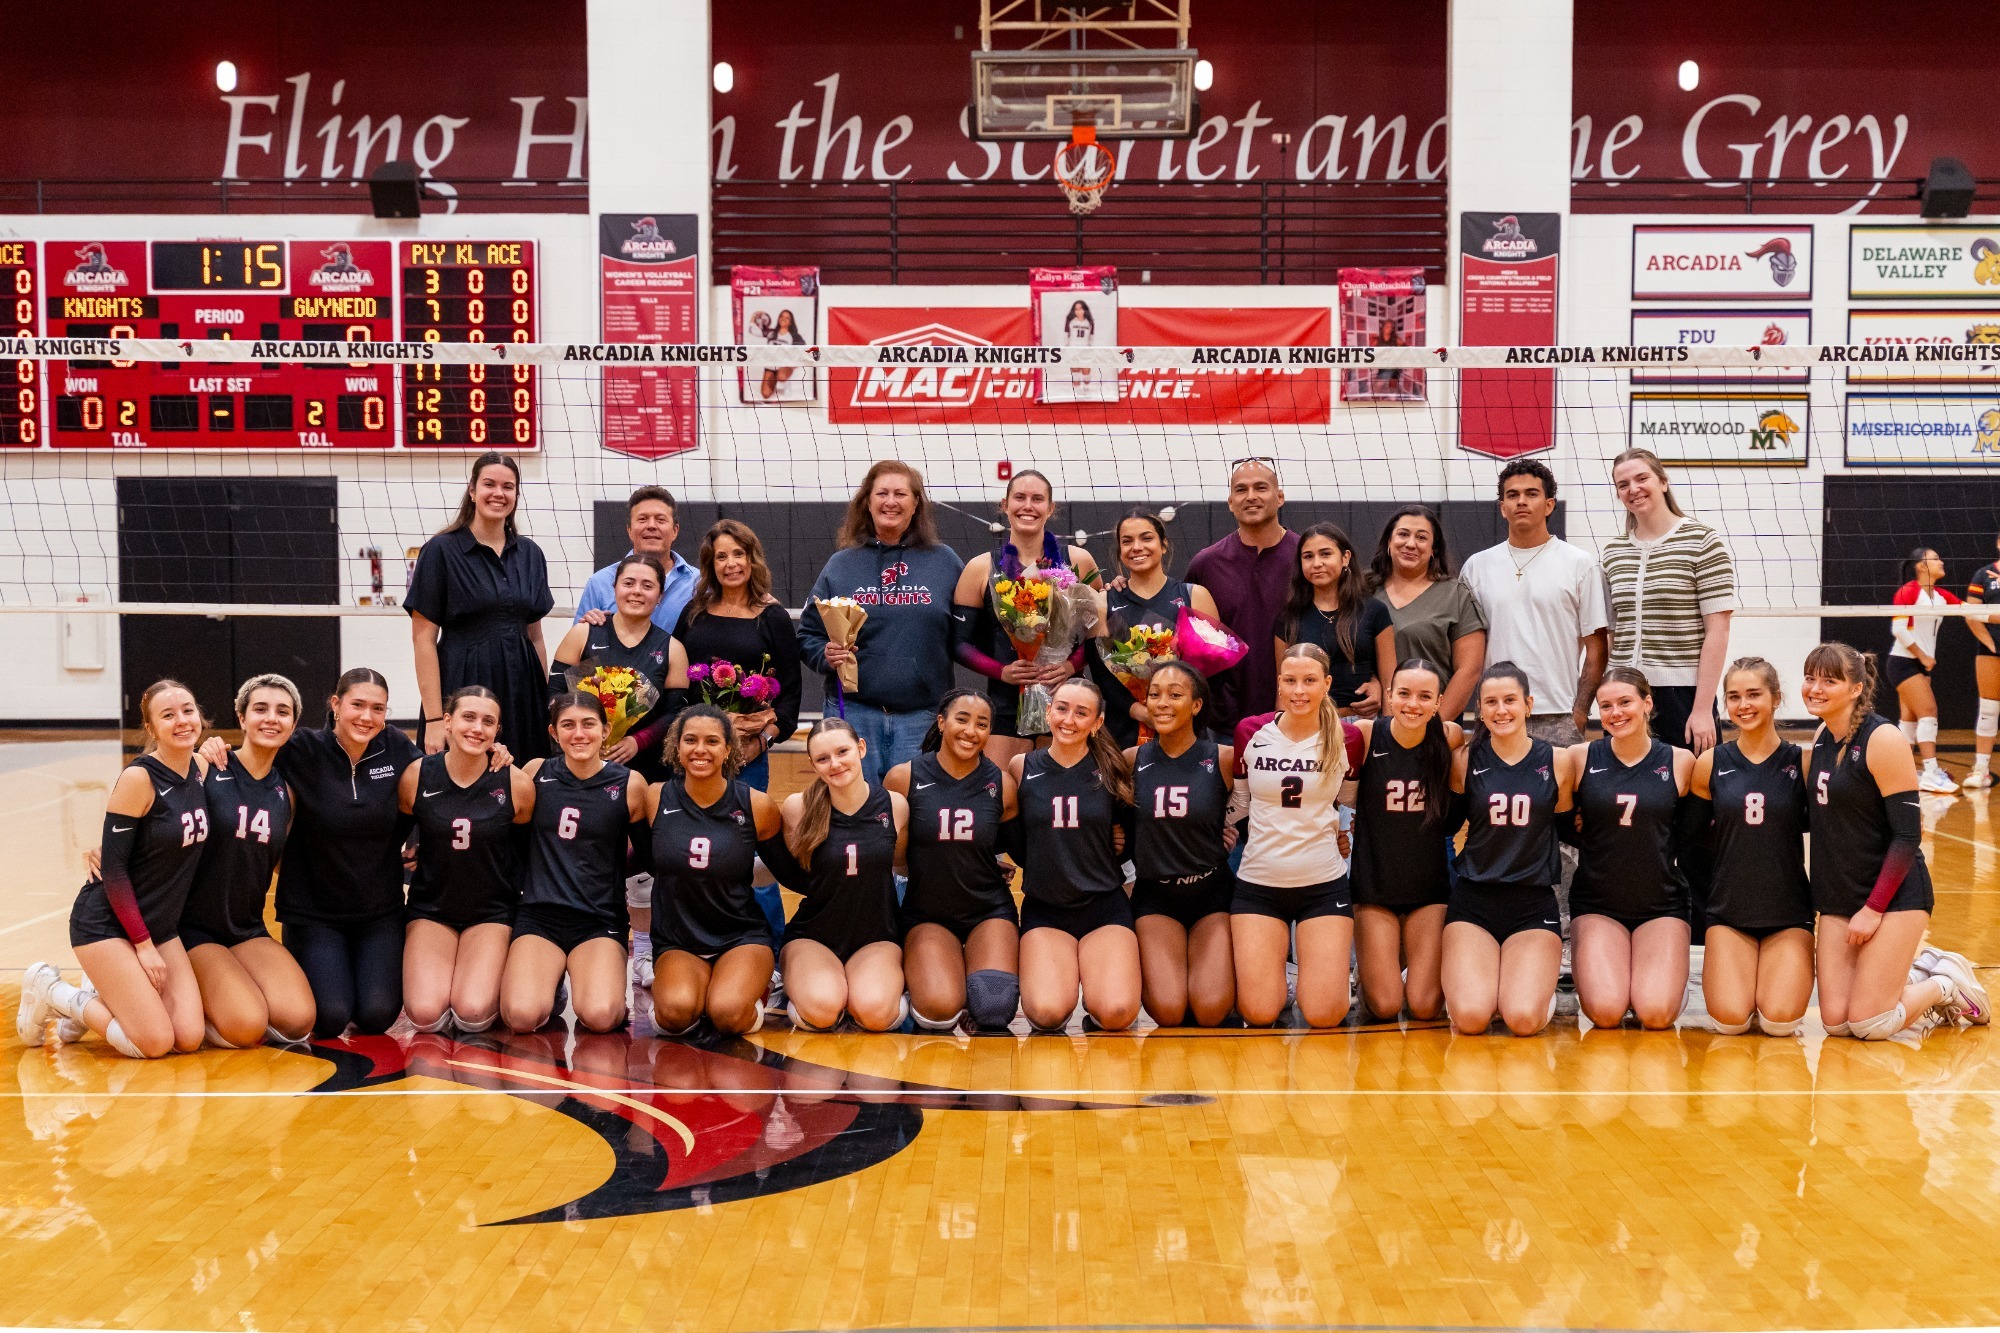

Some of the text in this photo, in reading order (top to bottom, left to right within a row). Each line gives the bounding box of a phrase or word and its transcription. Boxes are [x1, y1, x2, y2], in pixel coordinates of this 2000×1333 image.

[220, 72, 470, 214] Fling
[775, 73, 914, 188] the
[1681, 93, 1908, 215] Grey
[411, 244, 521, 265] PLY KL ACE
[623, 242, 675, 251] ARCADIA
[1485, 240, 1536, 250] ARCADIA
[1862, 247, 1962, 261] DELAWARE
[202, 244, 281, 287] 1:15
[1647, 255, 1742, 271] ARCADIA
[1877, 265, 1948, 279] VALLEY
[16, 269, 32, 294] 0
[66, 271, 127, 284] ARCADIA
[310, 271, 373, 284] ARCADIA
[425, 269, 528, 294] 3 0 0
[614, 279, 684, 287] CAREER RECORDS
[643, 271, 693, 279] VOLLEYBALL
[77, 284, 116, 292] KNIGHTS
[322, 284, 362, 292] KNIGHTS
[1368, 282, 1411, 290] Rothschild
[16, 299, 33, 324] 0
[64, 297, 143, 318] KNIGHTS
[195, 308, 244, 324] PERIOD
[294, 297, 377, 318] GWYNEDD
[426, 299, 529, 324] 7 0 0
[1678, 329, 1716, 344] FDU
[35, 339, 121, 356] KNIGHTS
[251, 341, 434, 359] ARCADIA KNIGHTS
[564, 343, 748, 361] ARCADIA KNIGHTS
[878, 346, 1062, 364] ARCADIA KNIGHTS
[1192, 347, 1375, 364] ARCADIA KNIGHTS
[1505, 345, 1689, 363] ARCADIA KNIGHTS
[1818, 345, 2000, 362] ARCADIA KNIGHTS
[18, 358, 34, 384] 0
[65, 377, 98, 393] WON
[189, 377, 252, 393] LAST SET
[345, 377, 378, 393] WON
[864, 366, 974, 398] MAC
[19, 388, 35, 413] 0
[417, 388, 530, 413] 12 0 0
[83, 396, 103, 430] 0
[120, 400, 136, 426] 2
[307, 401, 324, 426] 2
[363, 396, 384, 430] 0
[20, 418, 36, 443] 0
[417, 418, 530, 443] 19 0 0
[1640, 421, 1745, 436] MARYWOOD
[1749, 428, 1778, 450] M
[1851, 422, 1973, 437] MISERICORDIA
[111, 432, 147, 447] T.O.L.
[298, 432, 334, 447] T.O.L.
[852, 592, 932, 606] KNIGHTS
[369, 764, 395, 775] ARCADIA
[1280, 775, 1304, 809] 2
[1386, 780, 1425, 812] 22
[1816, 771, 1831, 805] 5
[1052, 796, 1080, 828] 11
[1154, 786, 1189, 818] 15
[1489, 793, 1531, 826] 20
[1616, 794, 1638, 826] 7
[1745, 792, 1765, 825] 8
[181, 808, 209, 847] 23
[235, 805, 271, 844] 14
[558, 806, 581, 840] 6
[938, 808, 974, 841] 12
[452, 818, 472, 850] 3
[689, 837, 711, 869] 9
[846, 843, 858, 876] 1
